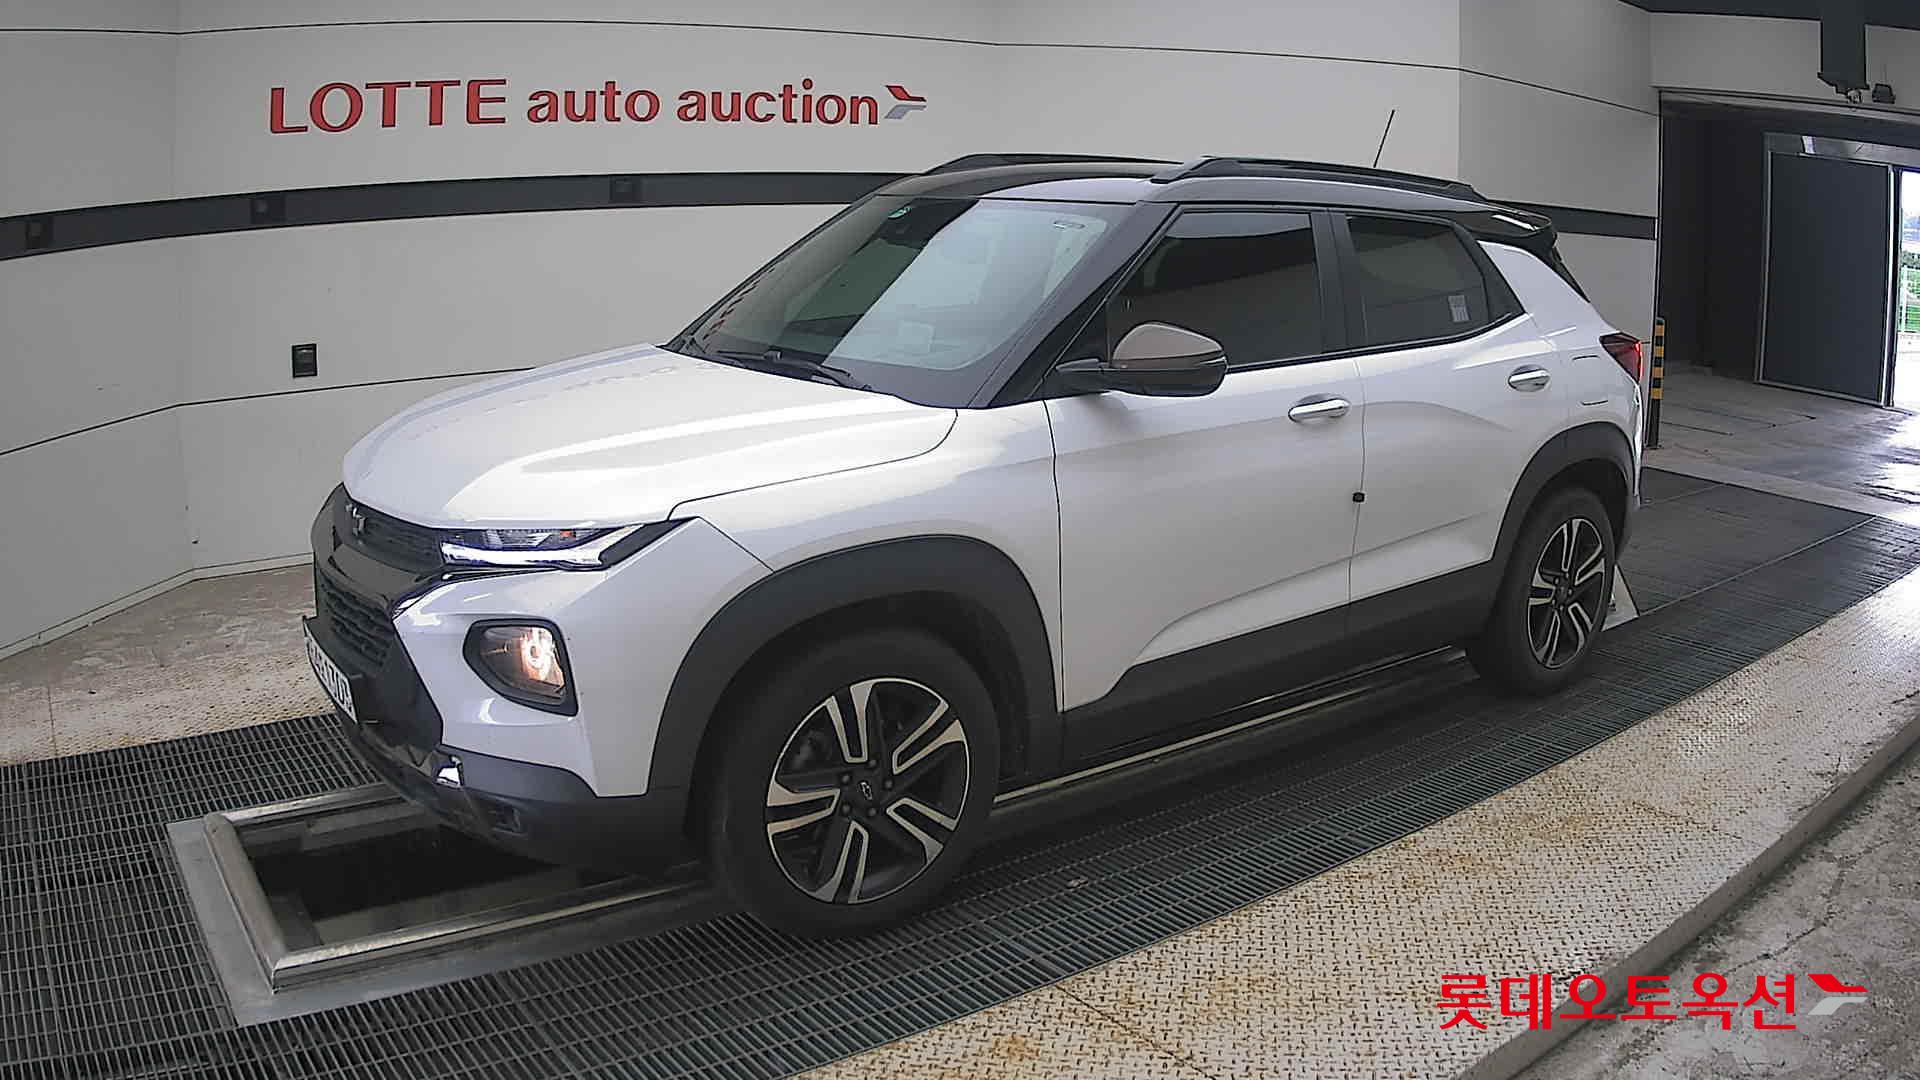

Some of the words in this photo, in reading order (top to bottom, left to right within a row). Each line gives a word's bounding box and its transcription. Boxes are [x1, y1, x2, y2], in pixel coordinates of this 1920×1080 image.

[270, 79, 506, 134] LOTTE
[527, 81, 660, 123] auto
[677, 78, 879, 125] auction
